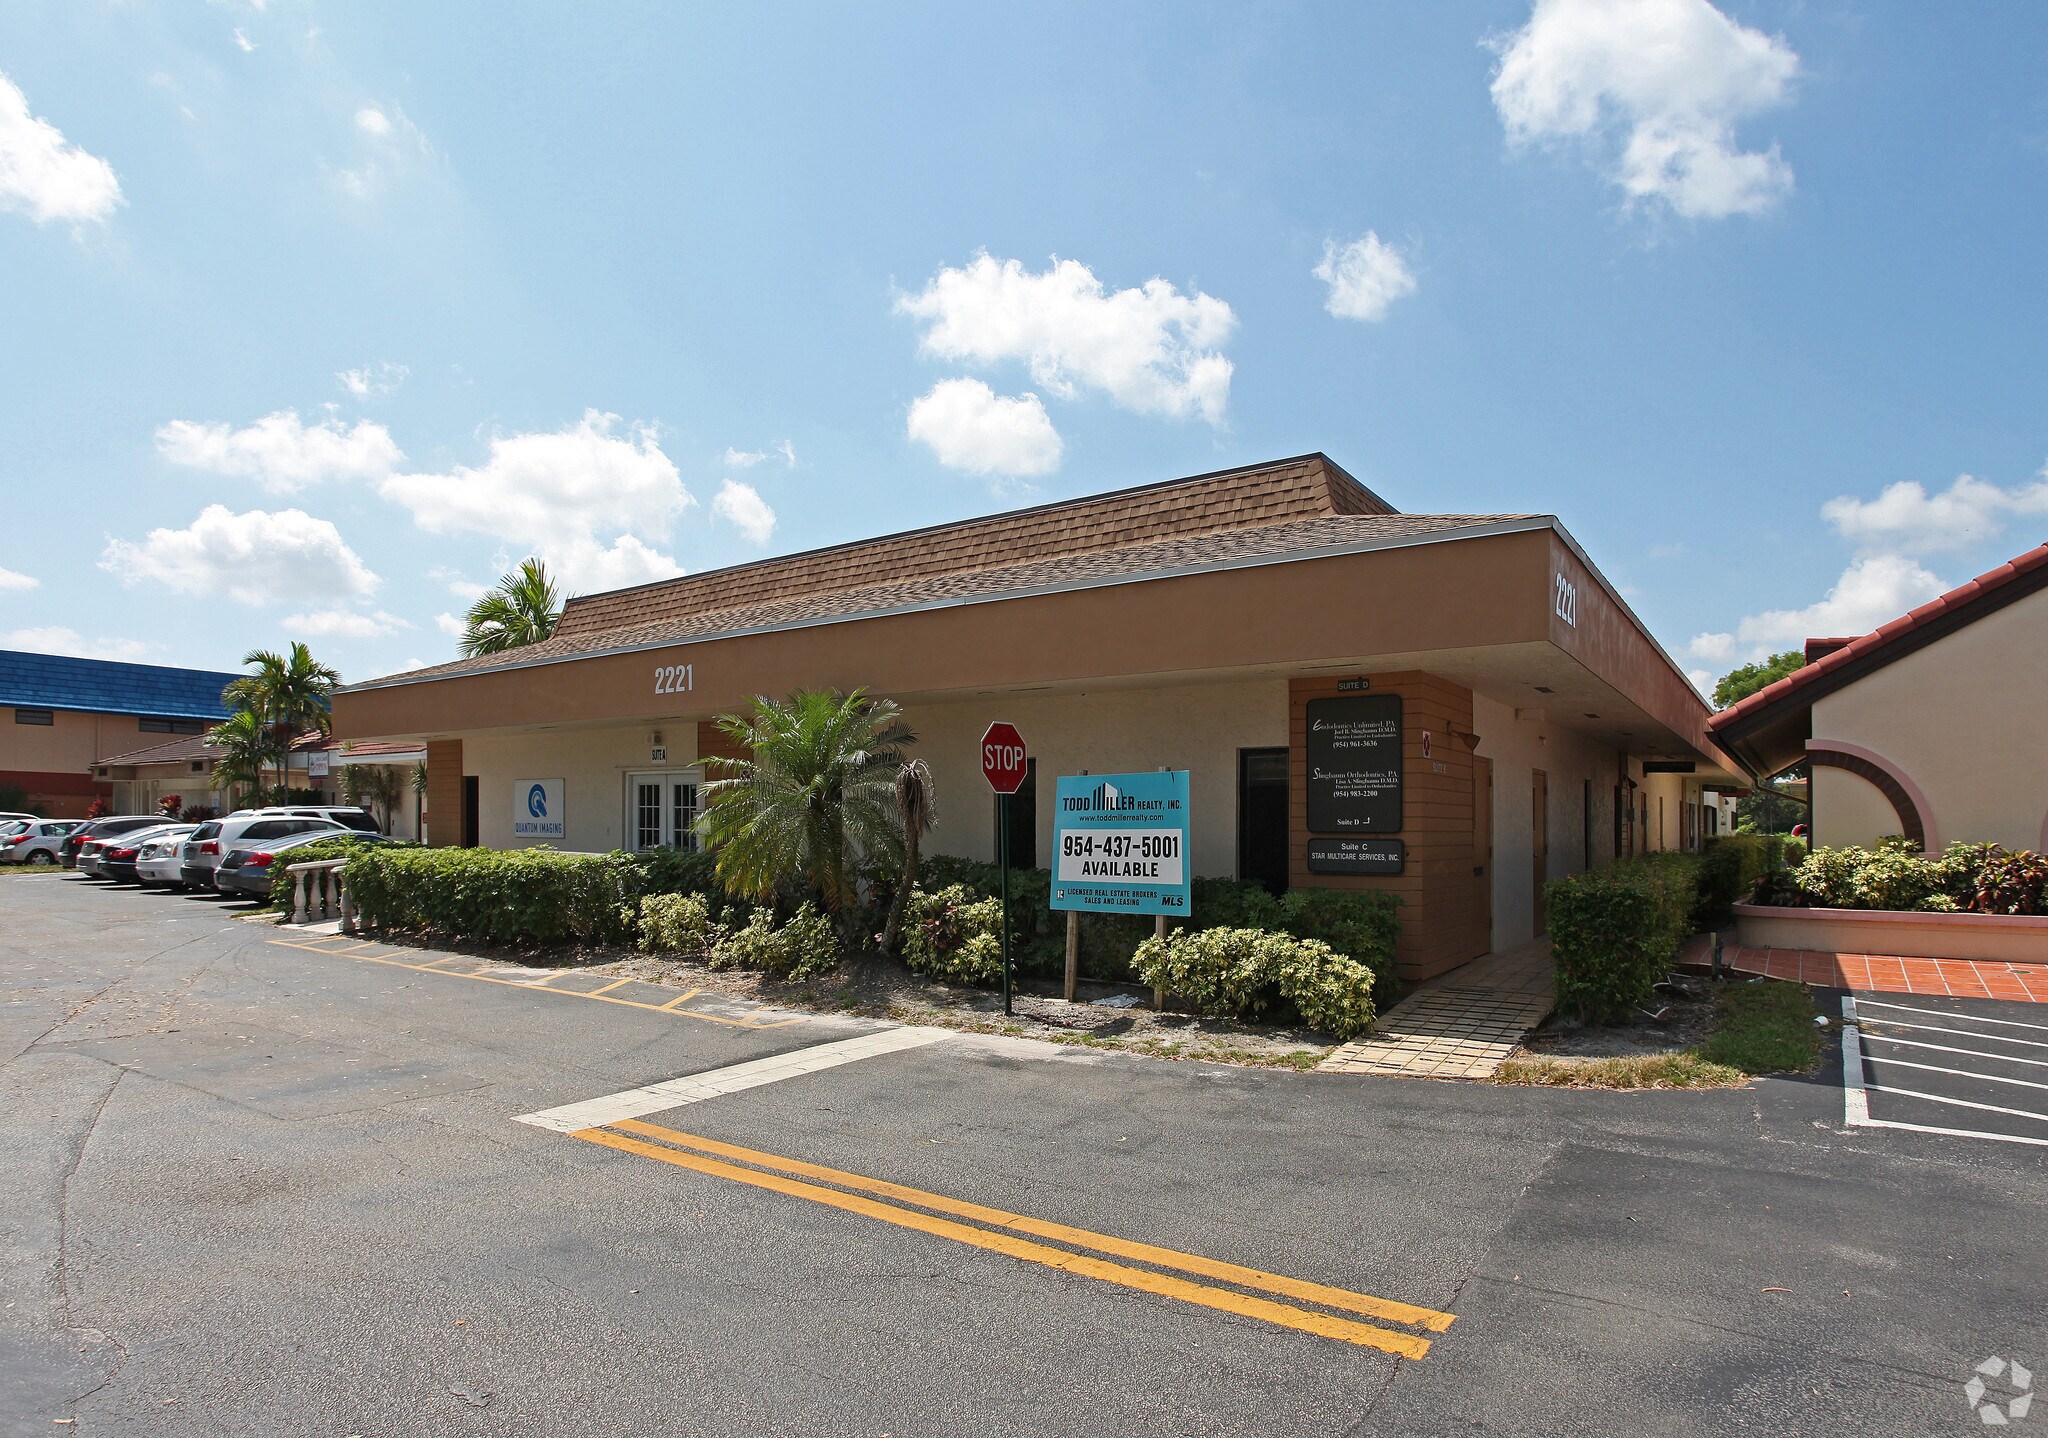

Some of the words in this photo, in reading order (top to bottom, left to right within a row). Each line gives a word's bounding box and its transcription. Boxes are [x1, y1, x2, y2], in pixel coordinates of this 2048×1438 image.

[1556, 572, 1576, 628] 2221
[654, 664, 693, 694] 2221
[652, 749, 662, 760] SUITE
[985, 744, 1024, 770] STOP
[1063, 798, 1090, 811] TODD
[1093, 782, 1134, 810] MILLER
[1138, 800, 1165, 810] REALTY,
[1168, 800, 1182, 809] INC.
[516, 822, 538, 833] QUANTUM
[539, 822, 562, 833] IMAGING
[1079, 814, 1164, 822] www.toddmillerrealty.com
[1064, 836, 1179, 858] 954-437-5001
[1082, 861, 1159, 877] AVAILABLE
[1162, 897, 1183, 906] MLS
